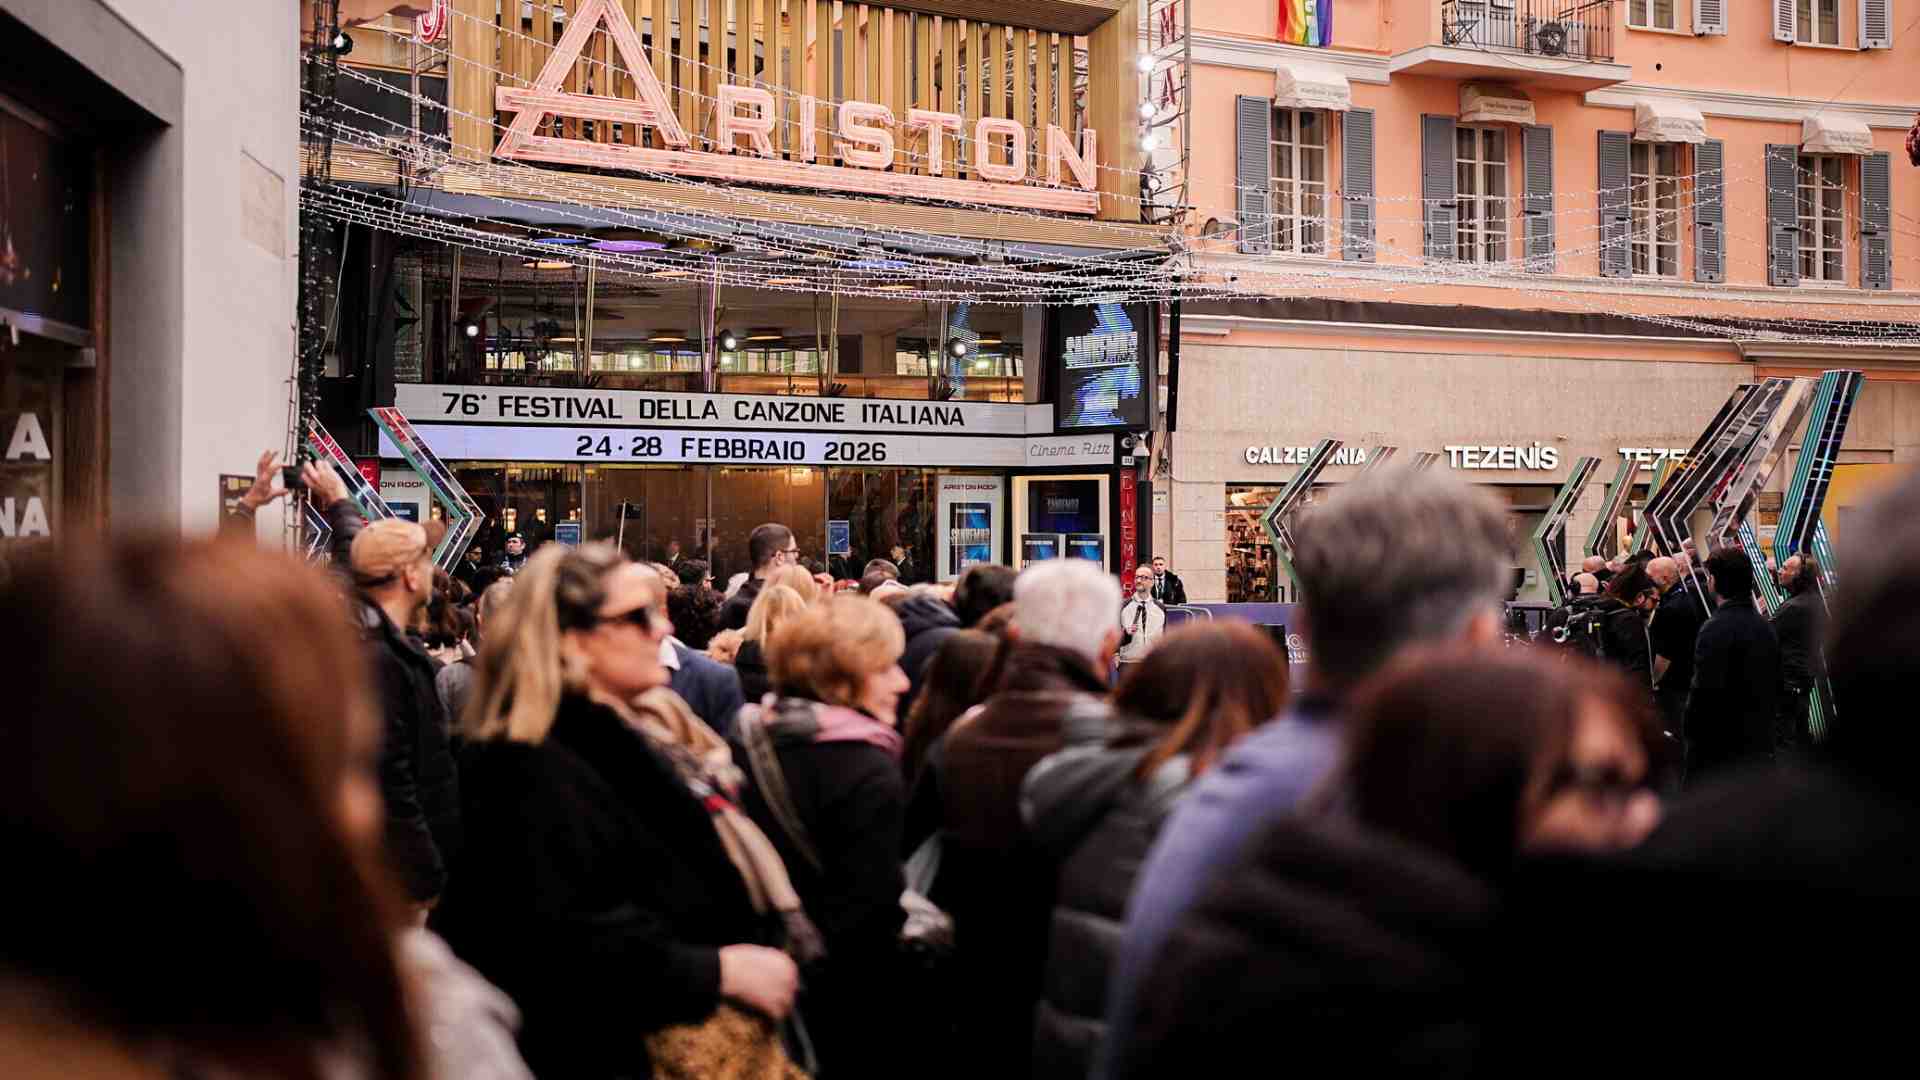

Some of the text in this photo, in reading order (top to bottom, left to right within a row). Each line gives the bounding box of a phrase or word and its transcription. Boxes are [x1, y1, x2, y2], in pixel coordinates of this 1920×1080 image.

[493, 0, 1099, 206] ARISTON
[498, 395, 623, 420] FESTIVAL
[639, 398, 719, 421] DELLA
[734, 401, 846, 424] CANZONE
[862, 404, 965, 427] ITALIANA
[681, 437, 806, 461] FEBBRAIO
[823, 441, 887, 462] 2026
[1031, 444, 1077, 457] Cinema
[1244, 446, 1367, 465] CALZENIA
